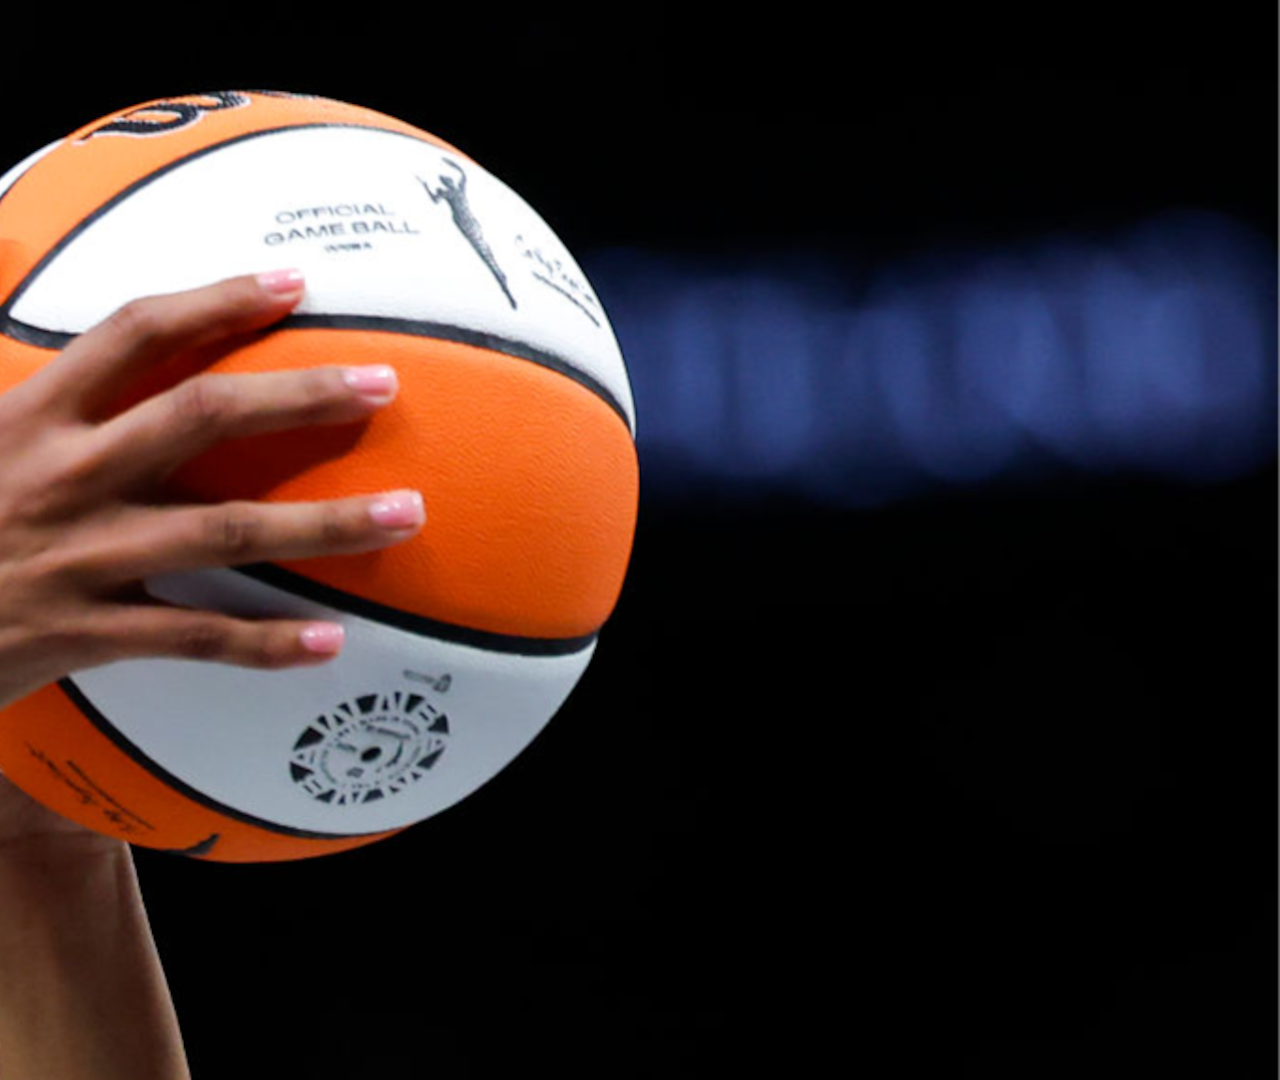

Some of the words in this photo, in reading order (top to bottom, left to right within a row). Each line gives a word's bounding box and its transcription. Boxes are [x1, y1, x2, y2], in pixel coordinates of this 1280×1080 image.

[275, 202, 395, 224] OFFICIAL
[264, 223, 345, 246] GAME
[351, 220, 421, 236] BALL
